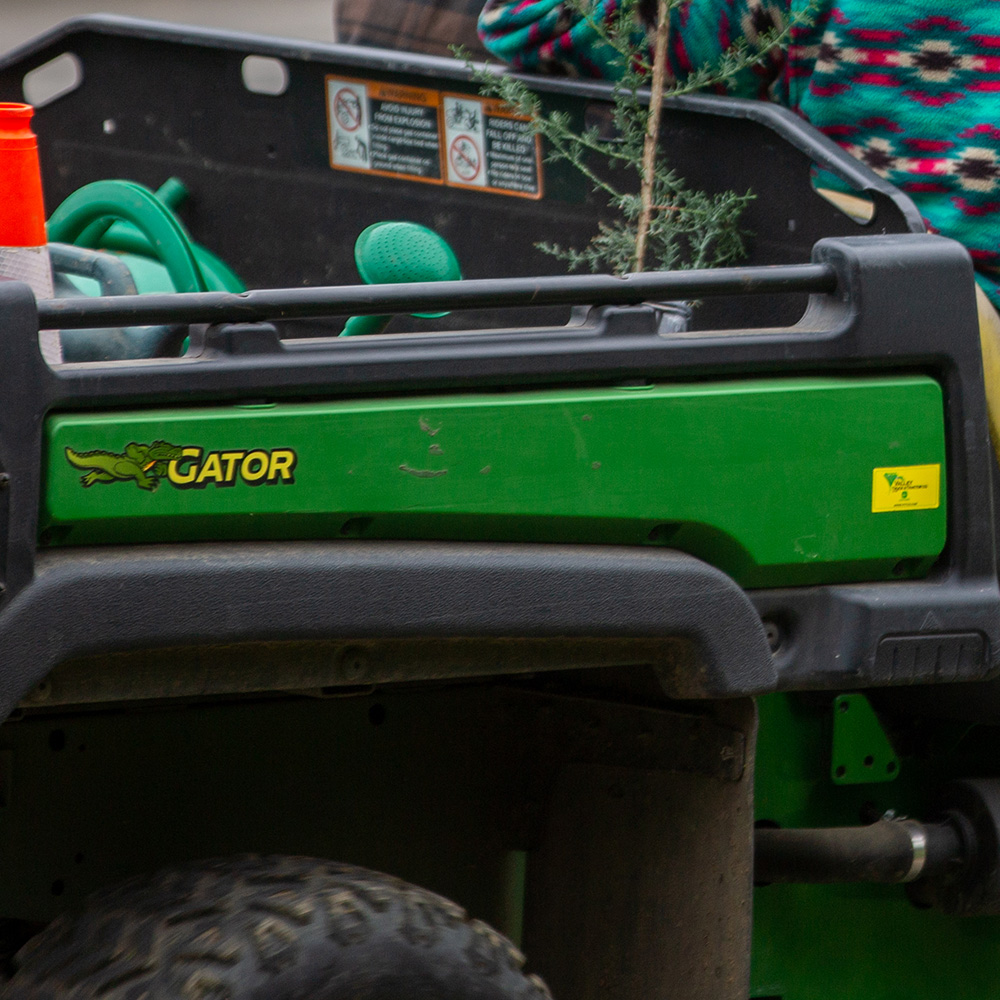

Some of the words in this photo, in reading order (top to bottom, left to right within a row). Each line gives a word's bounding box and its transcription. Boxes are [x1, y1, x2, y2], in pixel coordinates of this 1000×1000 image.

[373, 112, 393, 123] FROM
[485, 128, 503, 140] FALL
[502, 131, 517, 141] OFF
[168, 447, 296, 487] GATOR
